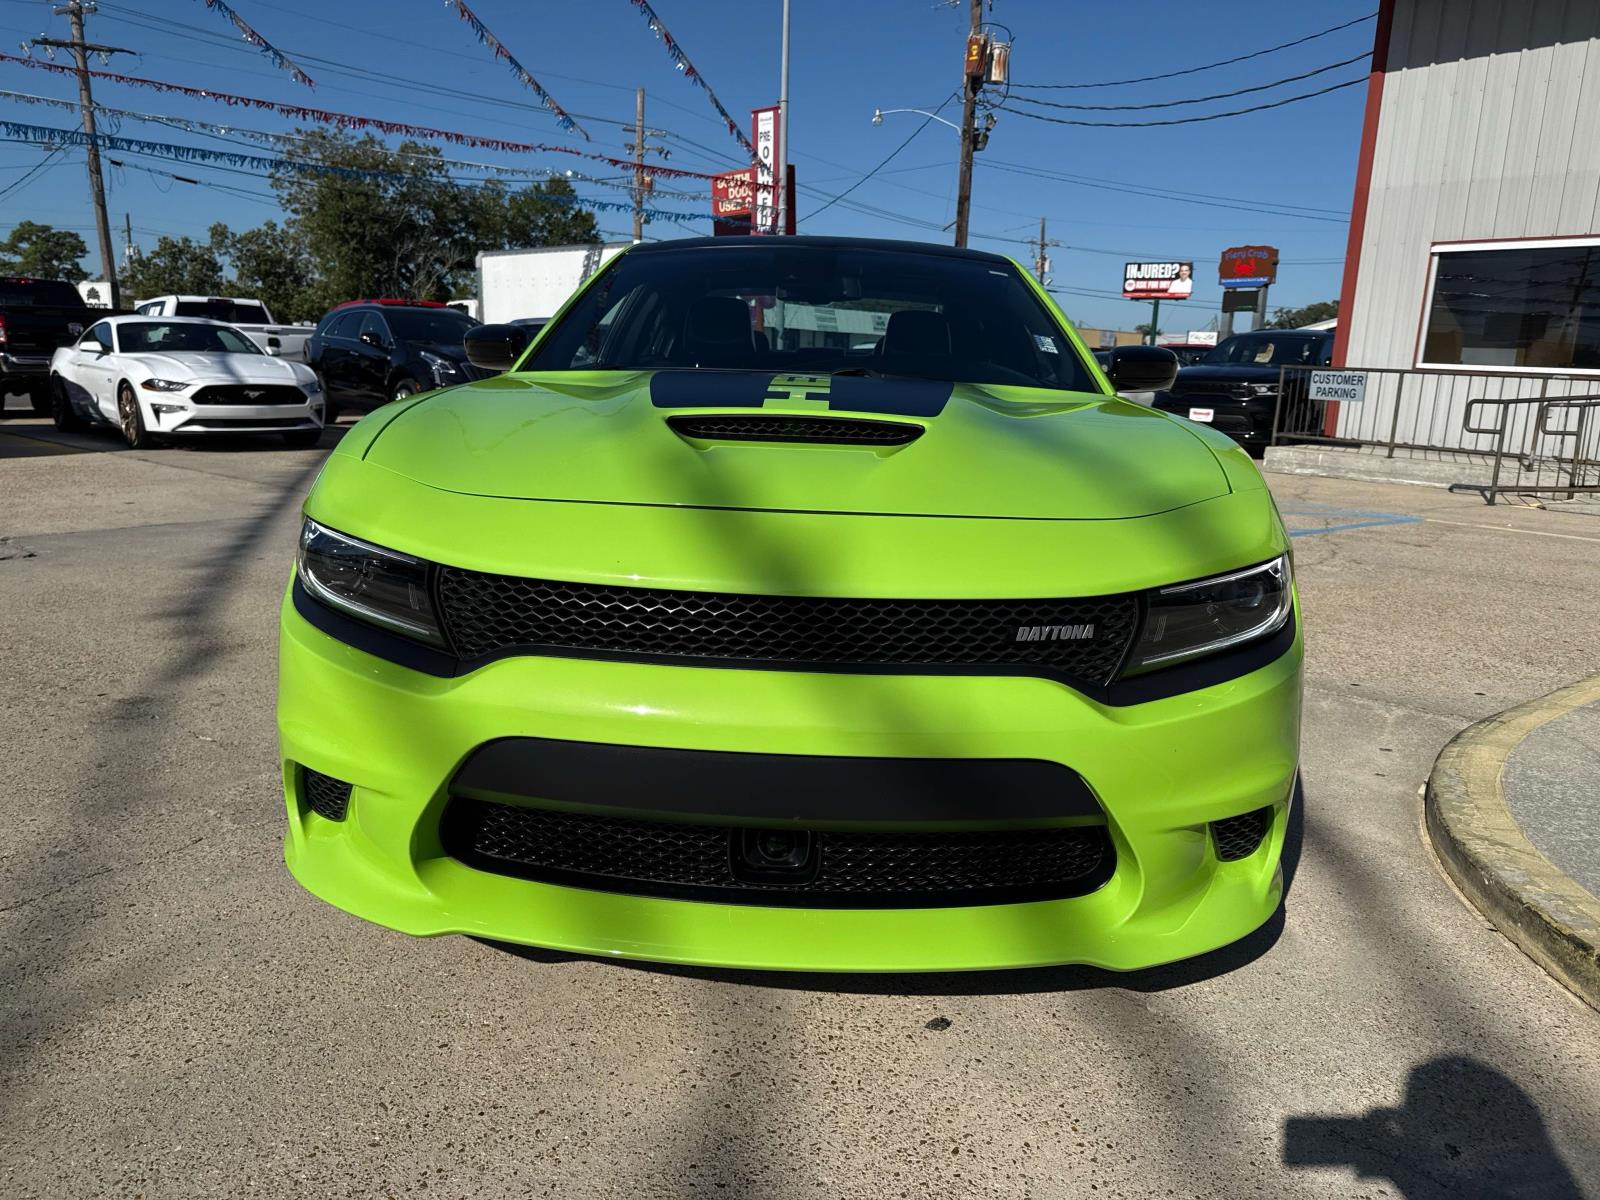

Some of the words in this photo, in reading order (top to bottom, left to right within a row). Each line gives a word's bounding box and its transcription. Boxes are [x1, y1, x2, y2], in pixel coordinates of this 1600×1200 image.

[1126, 263, 1180, 279] INJURED?
[1312, 373, 1364, 386] CUSTOMER
[1315, 386, 1357, 399] PARKING
[1015, 624, 1095, 642] DAYTONA
